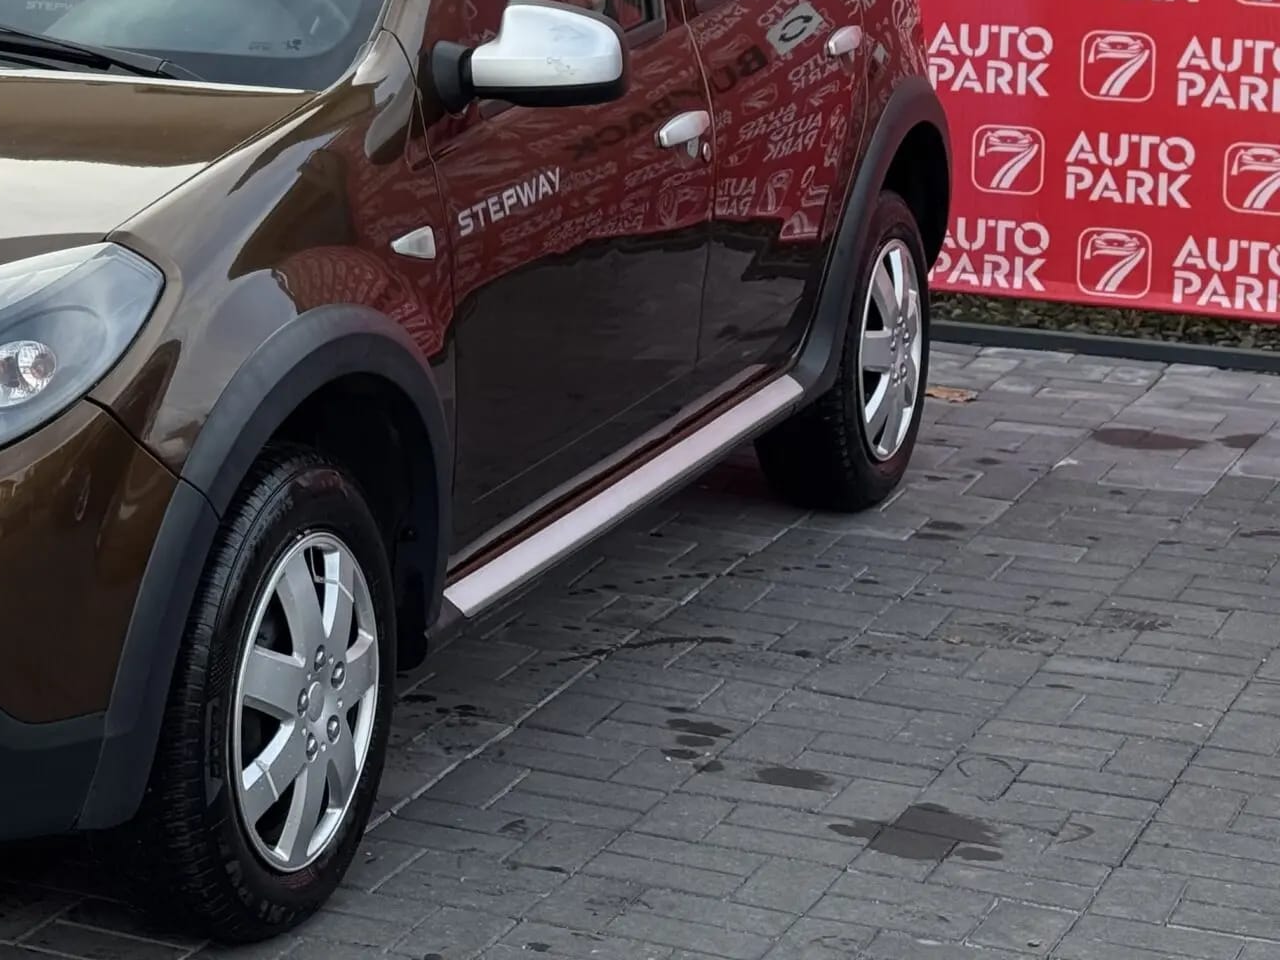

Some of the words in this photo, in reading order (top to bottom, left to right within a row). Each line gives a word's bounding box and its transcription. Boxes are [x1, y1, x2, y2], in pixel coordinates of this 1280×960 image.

[928, 23, 1054, 60] AUTO
[1177, 36, 1280, 74] AUT
[928, 57, 1049, 96] PARK
[1066, 131, 1195, 171] AUTO
[457, 165, 561, 237] STEPWAY
[1066, 166, 1191, 208] PARK
